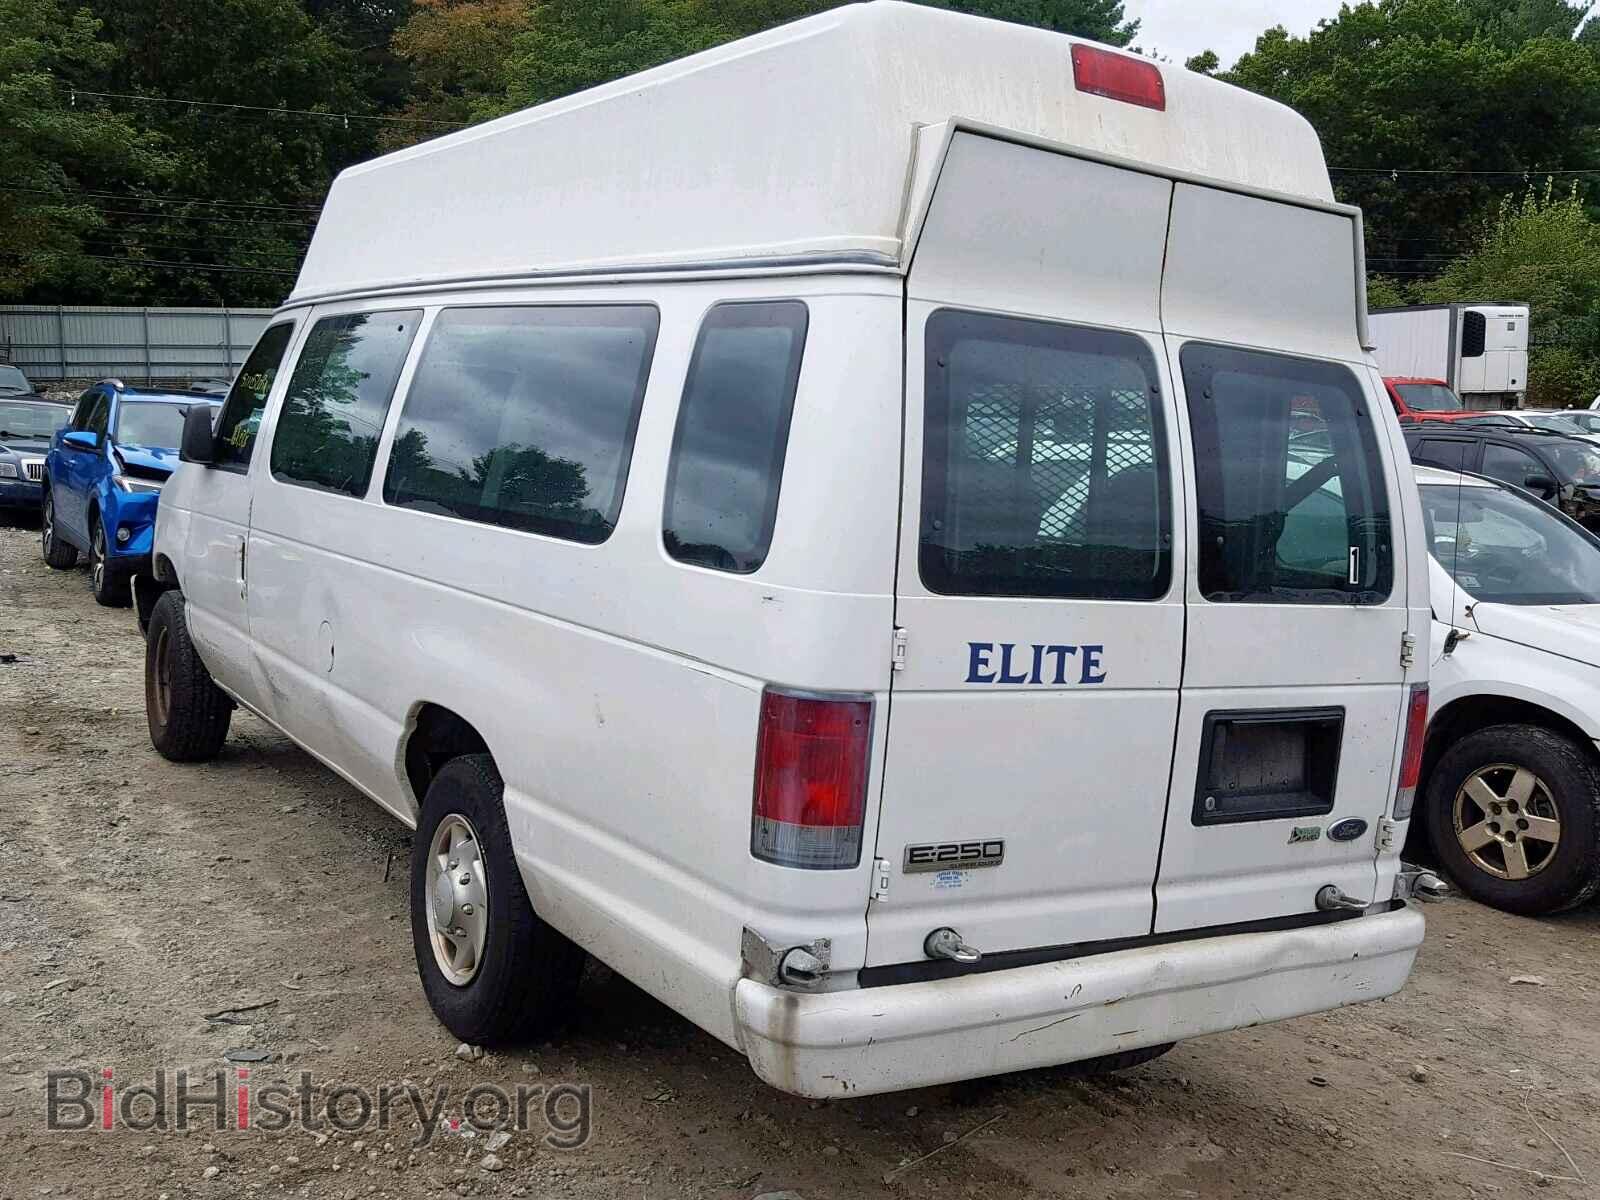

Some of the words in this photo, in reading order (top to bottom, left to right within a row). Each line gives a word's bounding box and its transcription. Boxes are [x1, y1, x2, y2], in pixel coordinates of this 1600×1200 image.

[1351, 547, 1358, 582] 1
[964, 642, 1107, 684] ELITE
[909, 841, 1003, 864] E-250
